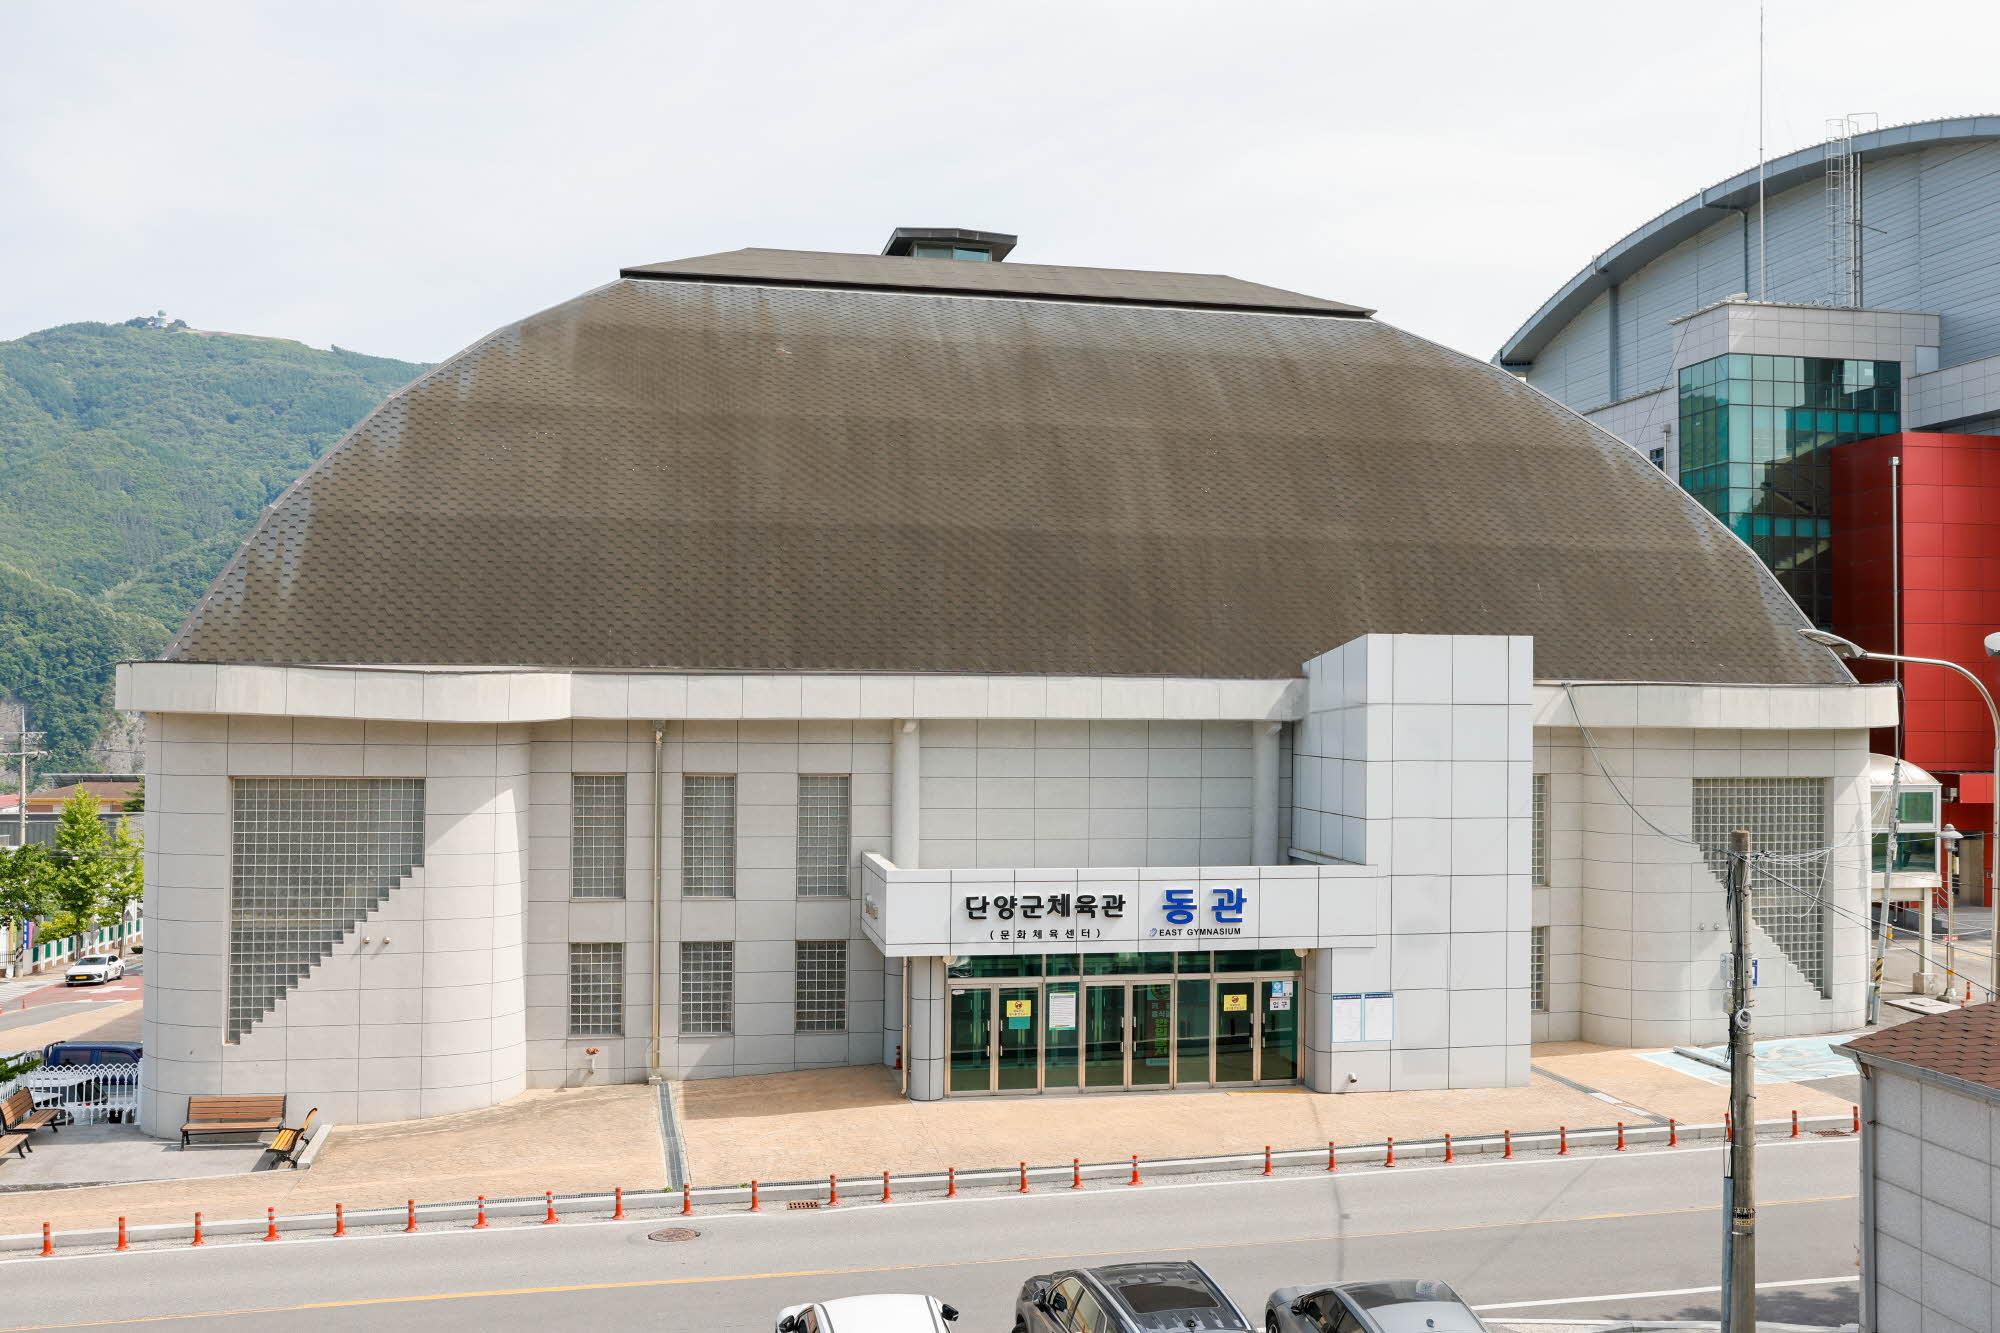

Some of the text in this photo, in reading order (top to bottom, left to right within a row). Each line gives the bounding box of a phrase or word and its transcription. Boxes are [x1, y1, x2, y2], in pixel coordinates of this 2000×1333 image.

[965, 893, 1126, 920] 단양군체육관
[1159, 927, 1241, 936] EAST GYMNASIUM
